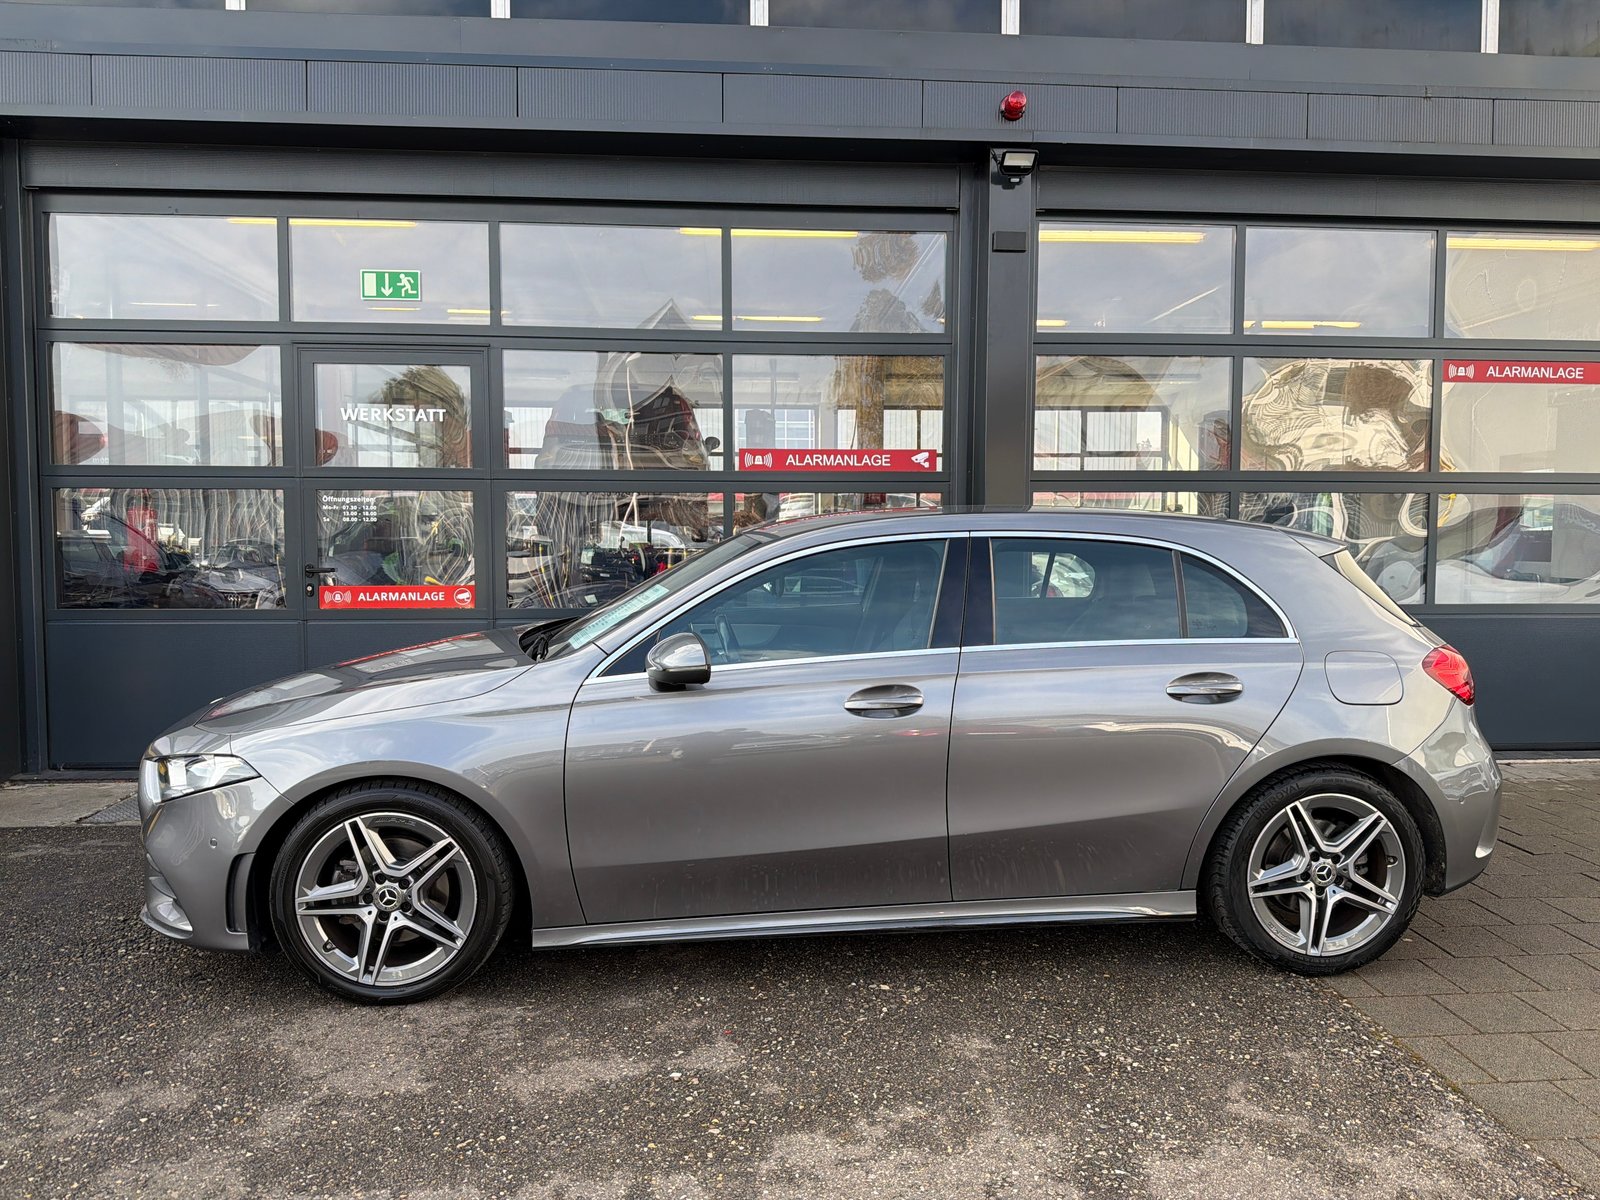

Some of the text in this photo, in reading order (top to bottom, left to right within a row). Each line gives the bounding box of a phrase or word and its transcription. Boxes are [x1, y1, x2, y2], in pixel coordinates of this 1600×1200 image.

[1486, 366, 1585, 379] ALARMANLAGE
[340, 407, 446, 422] WERKSTATT
[786, 454, 891, 466] ALARMANLAGE
[357, 592, 445, 602] ALARMANLAGE
[1254, 783, 1302, 820] UNIROYAL
